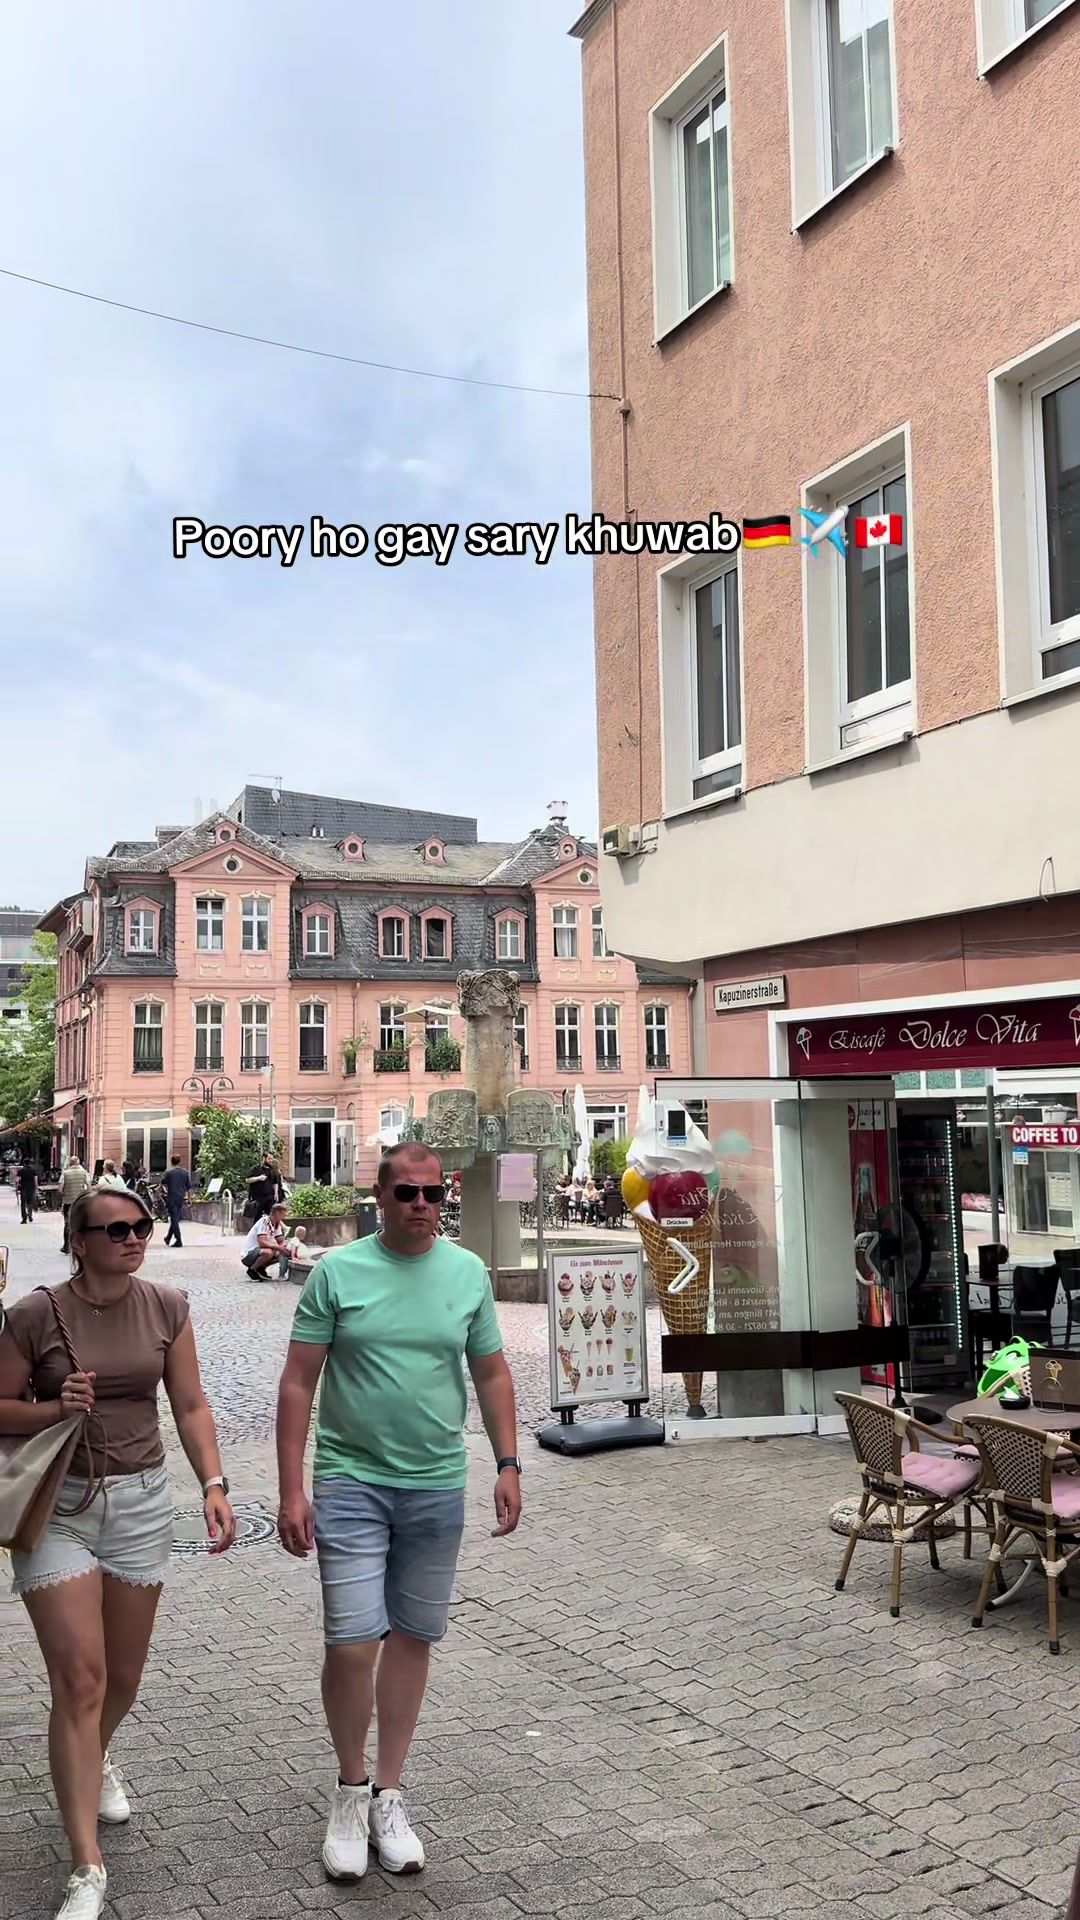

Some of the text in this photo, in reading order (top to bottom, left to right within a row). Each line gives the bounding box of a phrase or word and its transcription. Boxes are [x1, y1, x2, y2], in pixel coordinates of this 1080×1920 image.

[718, 982, 778, 1005] Kapuzinerstraße
[829, 1013, 1041, 1054] Eiscafé Dolce Vita
[1012, 1127, 1078, 1143] COFFEE TO
